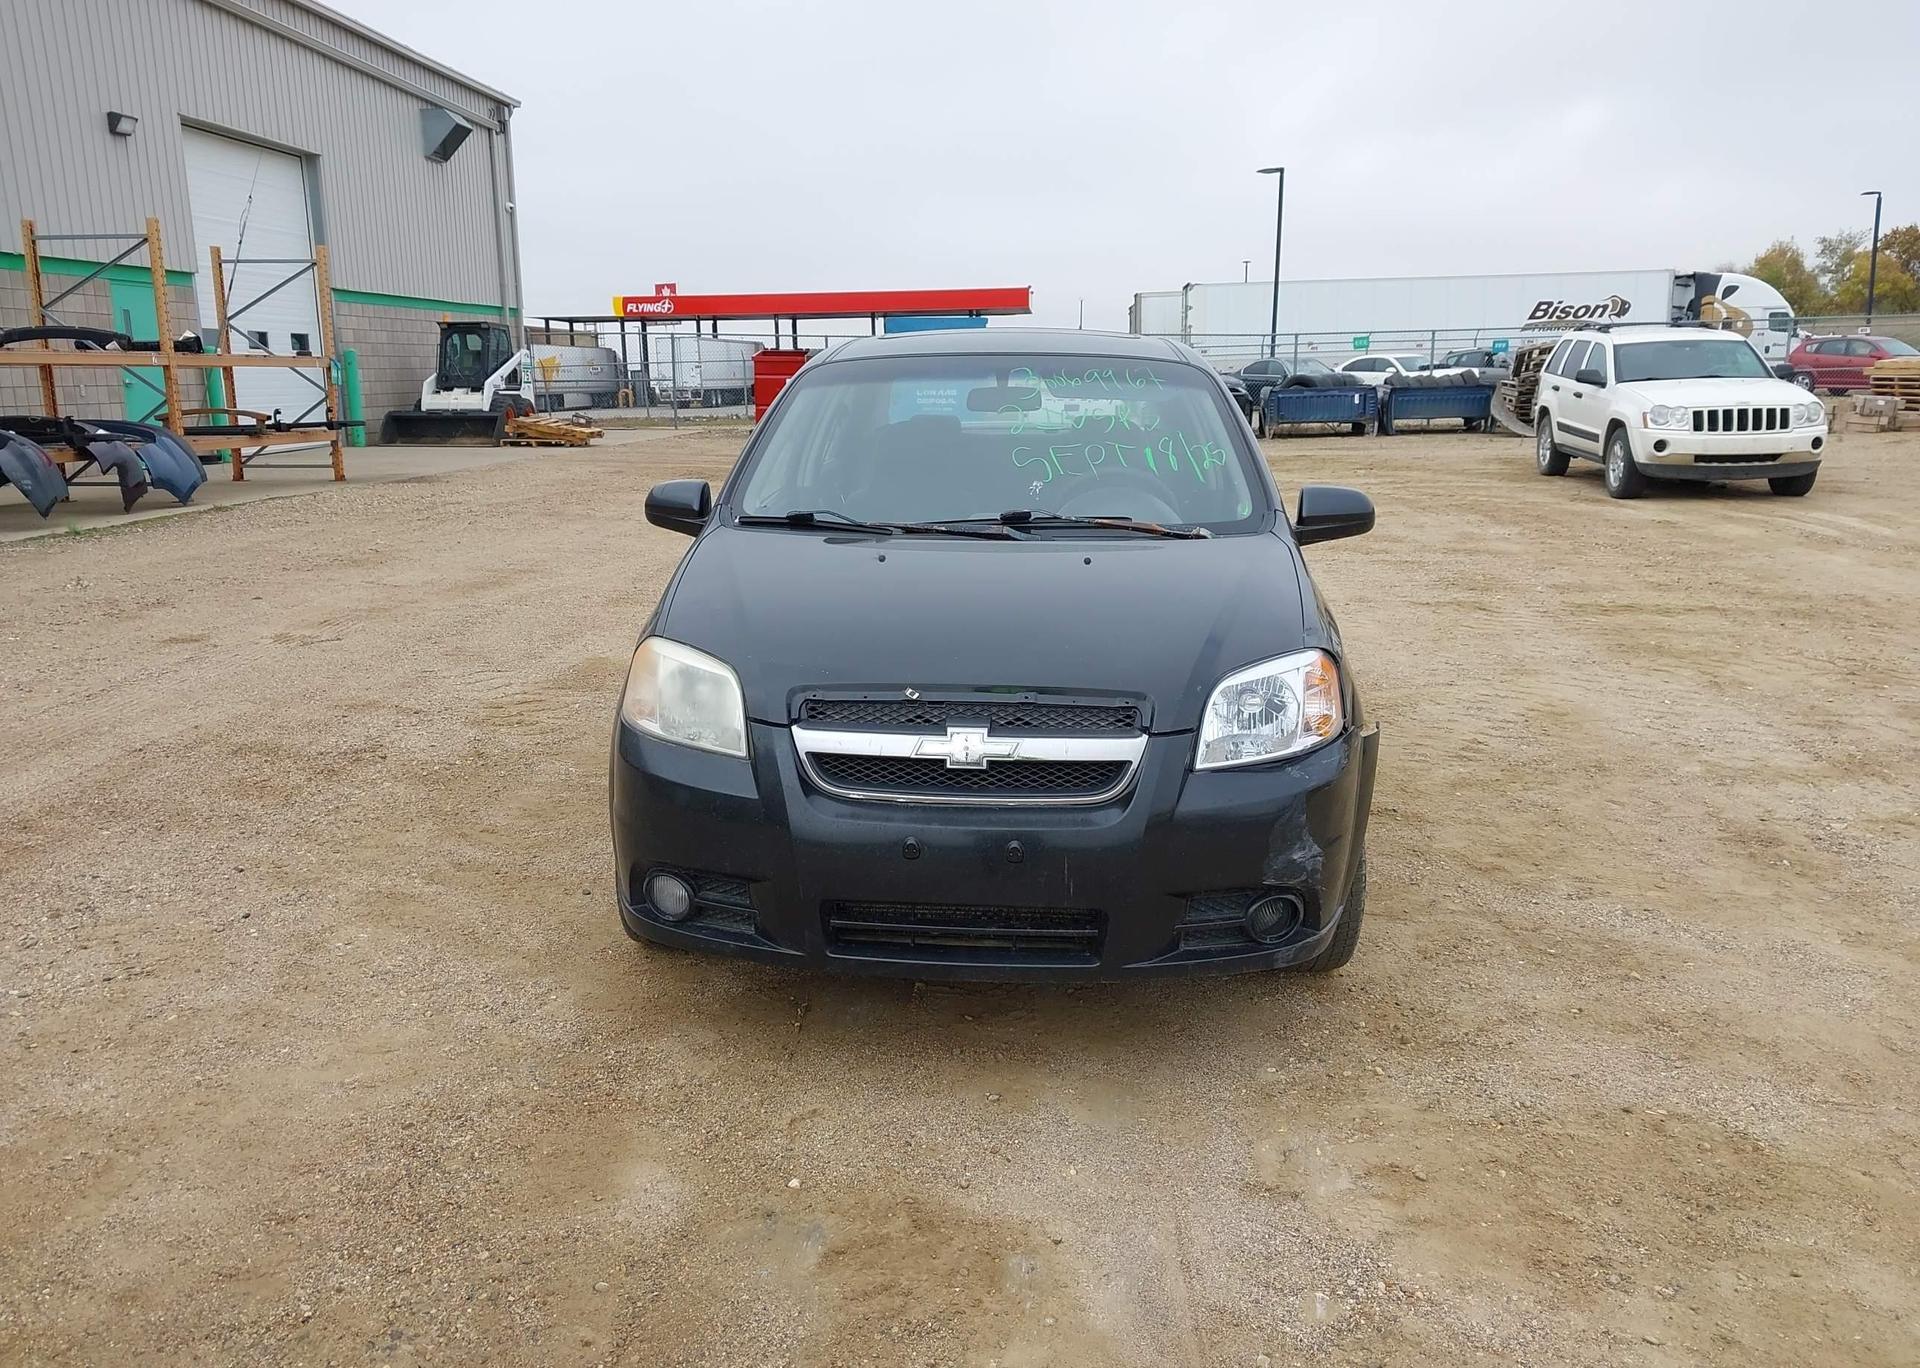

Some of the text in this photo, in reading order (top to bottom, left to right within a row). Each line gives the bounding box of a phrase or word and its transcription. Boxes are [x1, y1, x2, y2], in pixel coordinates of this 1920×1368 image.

[626, 302, 661, 313] FLYING
[1527, 300, 1610, 320] Bison
[1012, 441, 1136, 482] SEPT
